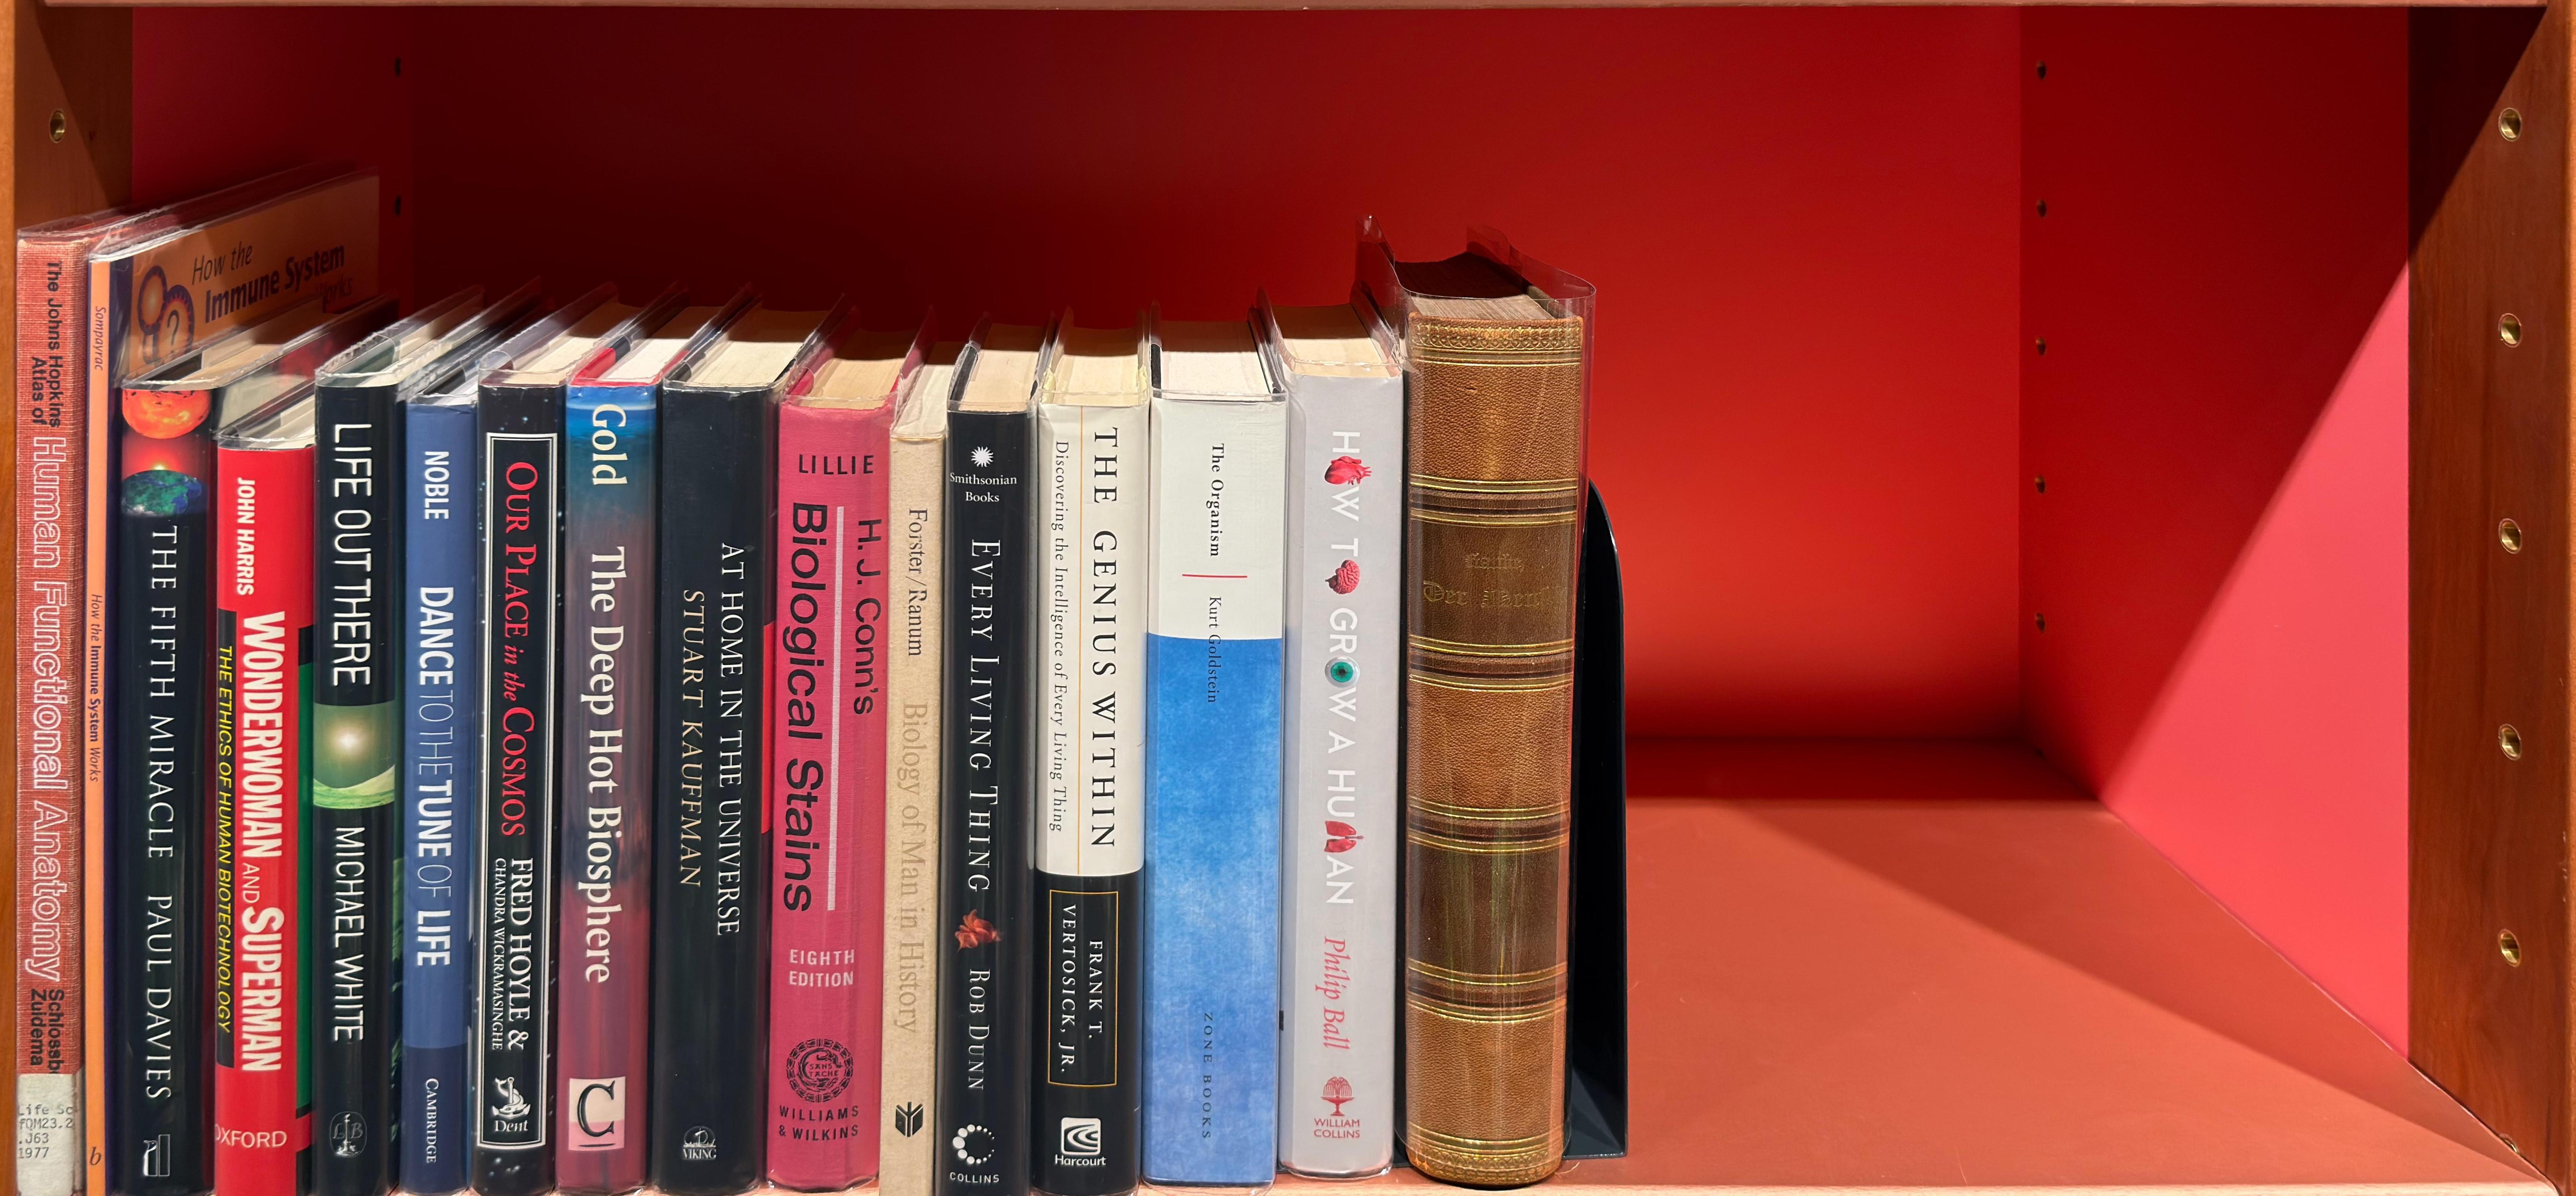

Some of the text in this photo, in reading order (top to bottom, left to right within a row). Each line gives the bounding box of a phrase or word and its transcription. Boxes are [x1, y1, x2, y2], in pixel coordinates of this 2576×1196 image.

[192, 241, 253, 285] How the
[205, 245, 344, 324] Immune System
[32, 357, 46, 425] Atlas of
[47, 261, 62, 428] The Johns Hopkins
[93, 306, 107, 371] Sompayrac
[424, 451, 450, 520] NOBLE
[592, 404, 628, 485] Gold
[799, 454, 874, 475] LILLIE
[950, 472, 1017, 486] Smithsonian
[966, 491, 1000, 502] Books
[237, 477, 255, 595] JOHN HARRIS
[1206, 443, 1225, 703] The Organism Kurt Goldstein
[501, 462, 538, 836] OUR PLACE in the COSMOS
[854, 519, 882, 715] H. J. Conn's
[1049, 441, 1069, 832] Discovering the Intelligence of Every Living Thing
[1091, 427, 1118, 847] THE GENIUS WITHIN
[25, 437, 68, 982] Human Functional Anatomy
[89, 594, 102, 782] How the Immune System Works
[334, 424, 372, 1041] LIFE OUT THERE MICHAEL WHITE
[681, 590, 705, 887] STUART KAUFFMAN
[717, 543, 744, 936] AT HOME IN THE UNIVERSE
[783, 502, 827, 912] Biological Stains
[968, 539, 1001, 892] EVERY LIVING THING
[1327, 731, 1356, 754] A
[146, 525, 177, 1099] THE FIFTH MIRACLE PAUL DAVIES
[417, 587, 454, 966] DANCE TO THE TUNE OF LIFE
[578, 546, 627, 983] The Deep Hot Biosphere
[217, 646, 232, 1033] THE ETHICS OF HUMAN BIOTECHNOLOGY
[241, 611, 285, 1071] WONDERWOMAN AND SUPERMAN
[894, 702, 928, 1033] Biology of Man in History
[492, 858, 507, 1051] CHANDRA WICKRAMASINGHE
[508, 858, 534, 1051] FRED HOYLE &
[789, 949, 855, 966] EIGHTH
[789, 971, 854, 987] EDITION
[1059, 904, 1076, 1073] VERTOSICK, JR.
[1089, 940, 1103, 1039] FRANK T.
[1315, 936, 1351, 1050] Philip Ball
[30, 989, 47, 1065] Zuidema
[968, 969, 991, 1090] ROB DUNN
[1202, 1012, 1213, 1139] ZONE BOOKS
[18, 1147, 49, 1158] 1977
[425, 1078, 439, 1164] CAMBRIDGE
[494, 1119, 529, 1132] Dent
[577, 1080, 616, 1137] C
[683, 1149, 716, 1159] VIKING
[779, 1105, 859, 1122] WILLIAMS
[779, 1124, 859, 1142] & WILKINS
[1055, 1154, 1106, 1166] Harcourt
[1314, 1118, 1360, 1127] WILLIAM
[1314, 1129, 1360, 1138] COLLINS
[950, 1171, 1000, 1183] COLLINS
